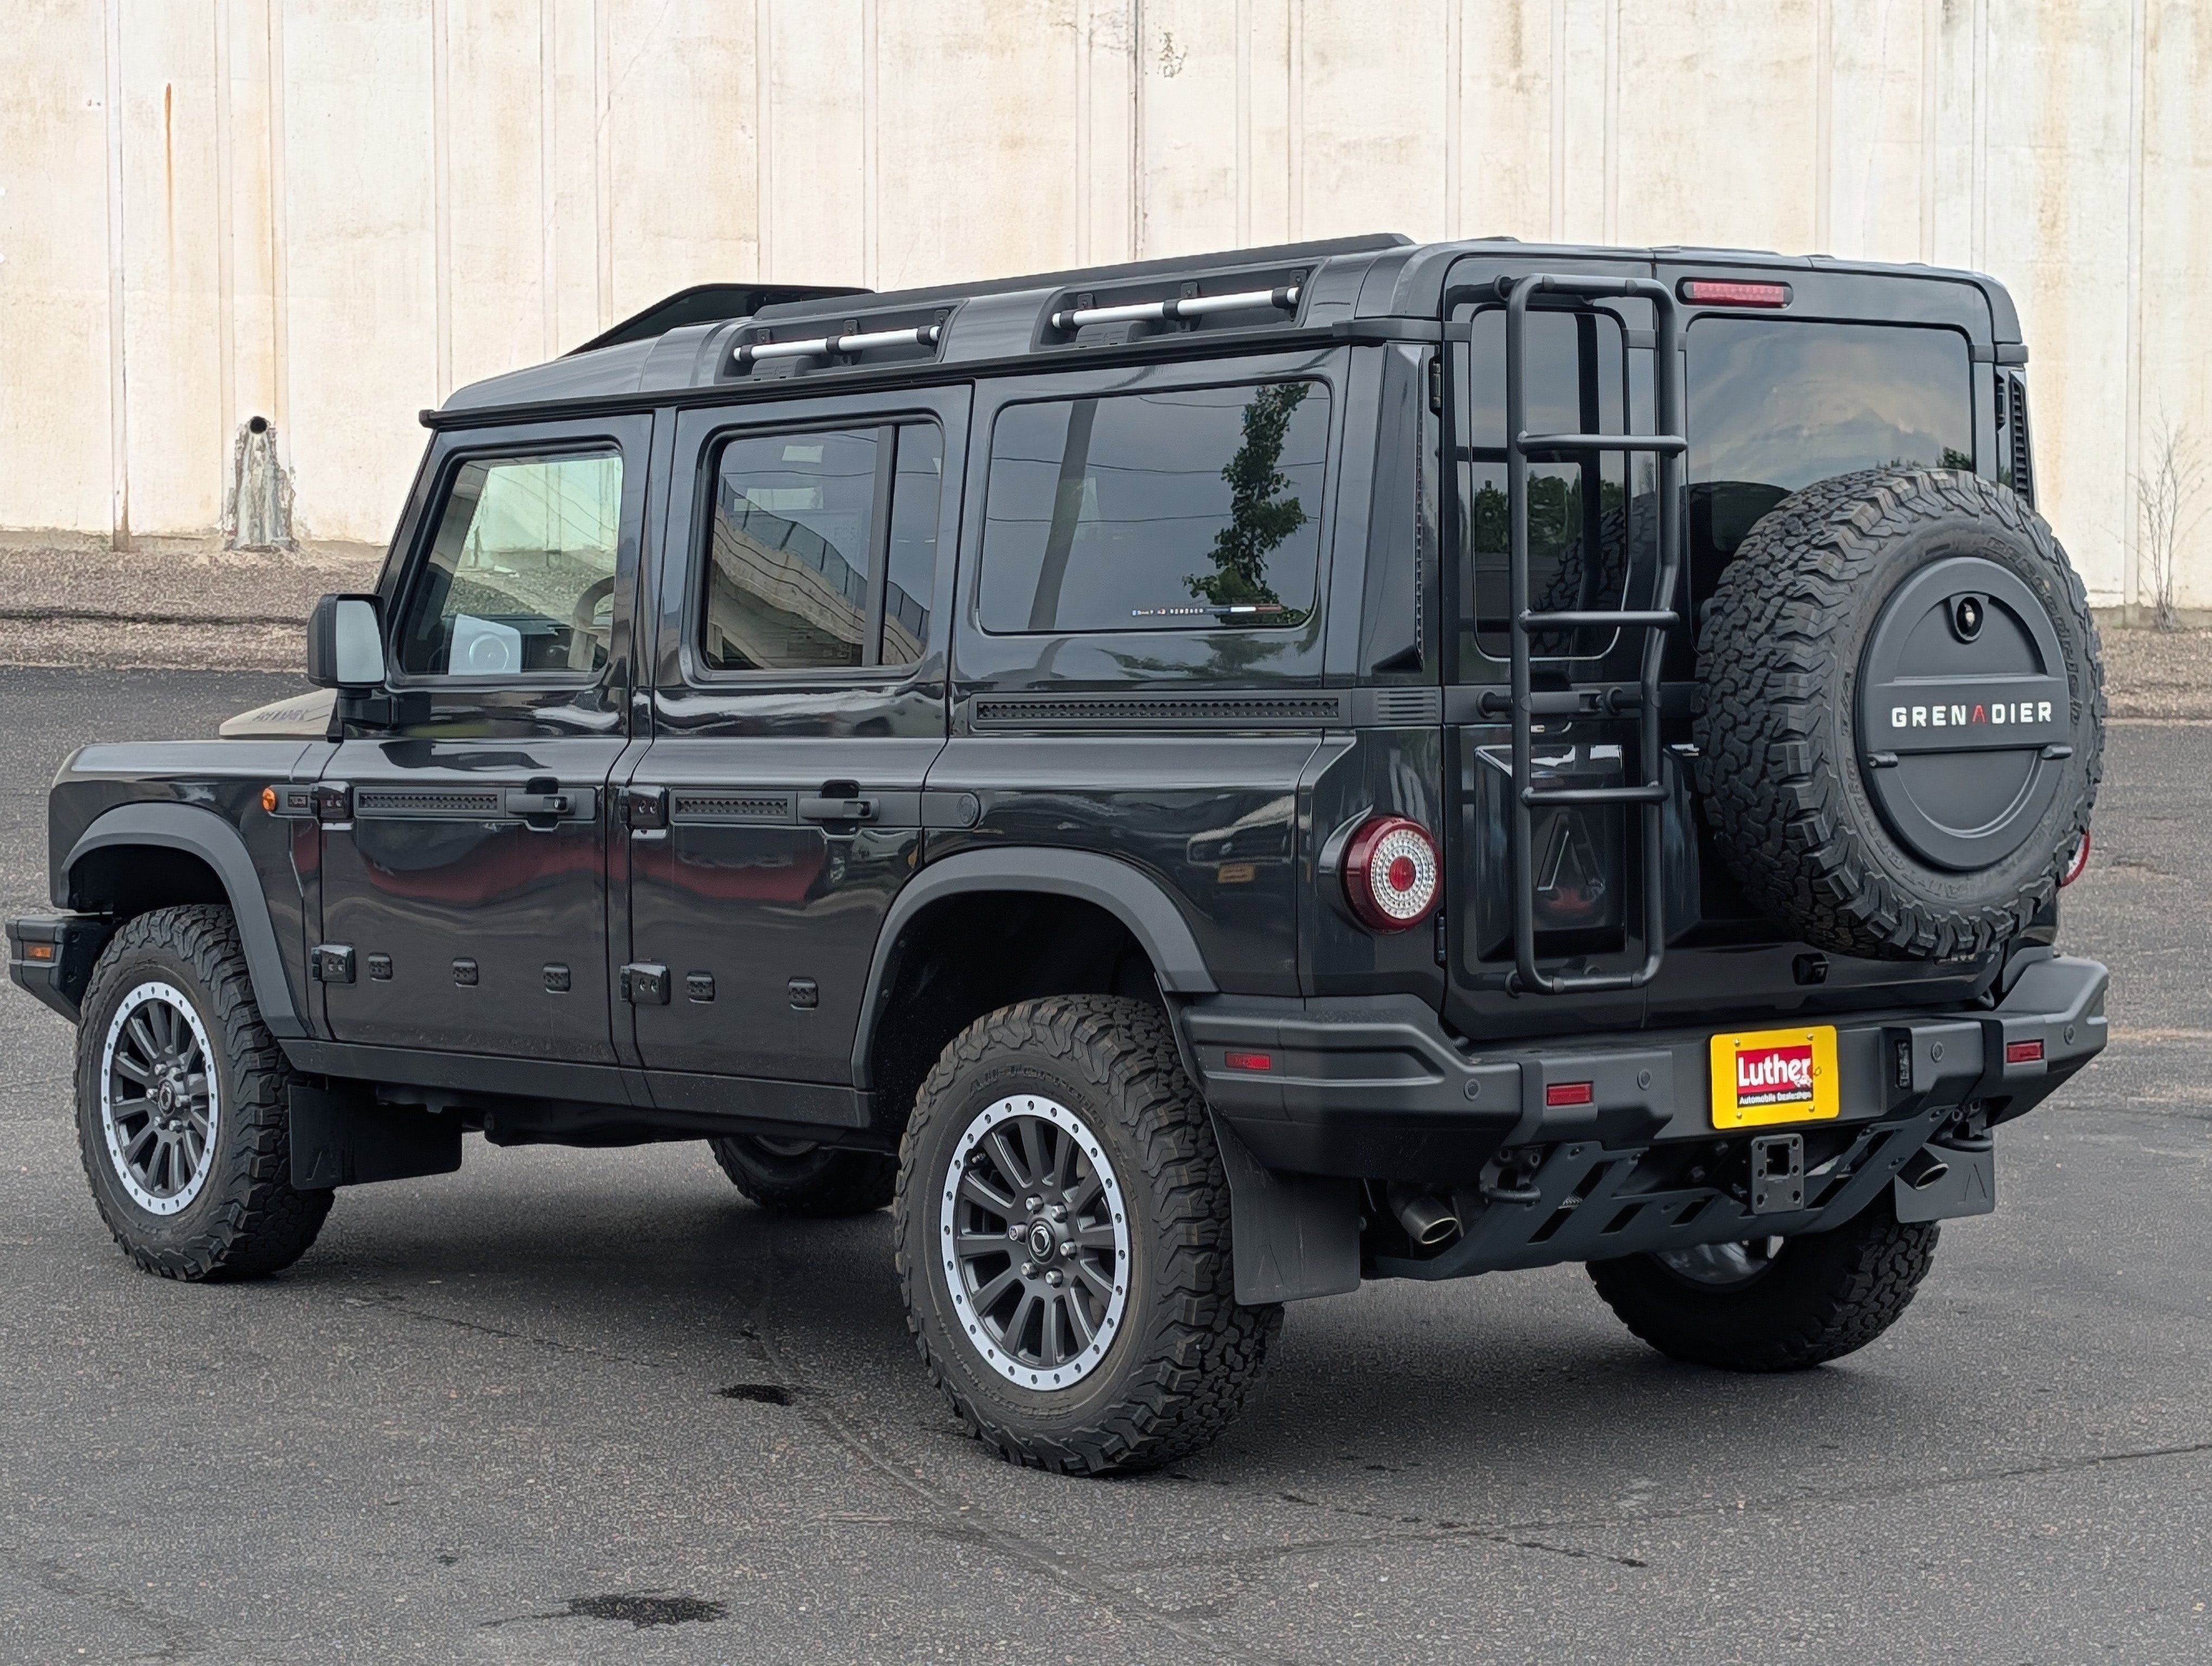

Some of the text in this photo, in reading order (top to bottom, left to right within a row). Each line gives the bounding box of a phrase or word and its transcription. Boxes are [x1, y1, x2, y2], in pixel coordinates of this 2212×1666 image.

[1891, 701, 2052, 727] GRENADIER
[1738, 1053, 1811, 1087] Luther
[1739, 1092, 1777, 1105] Automobile
